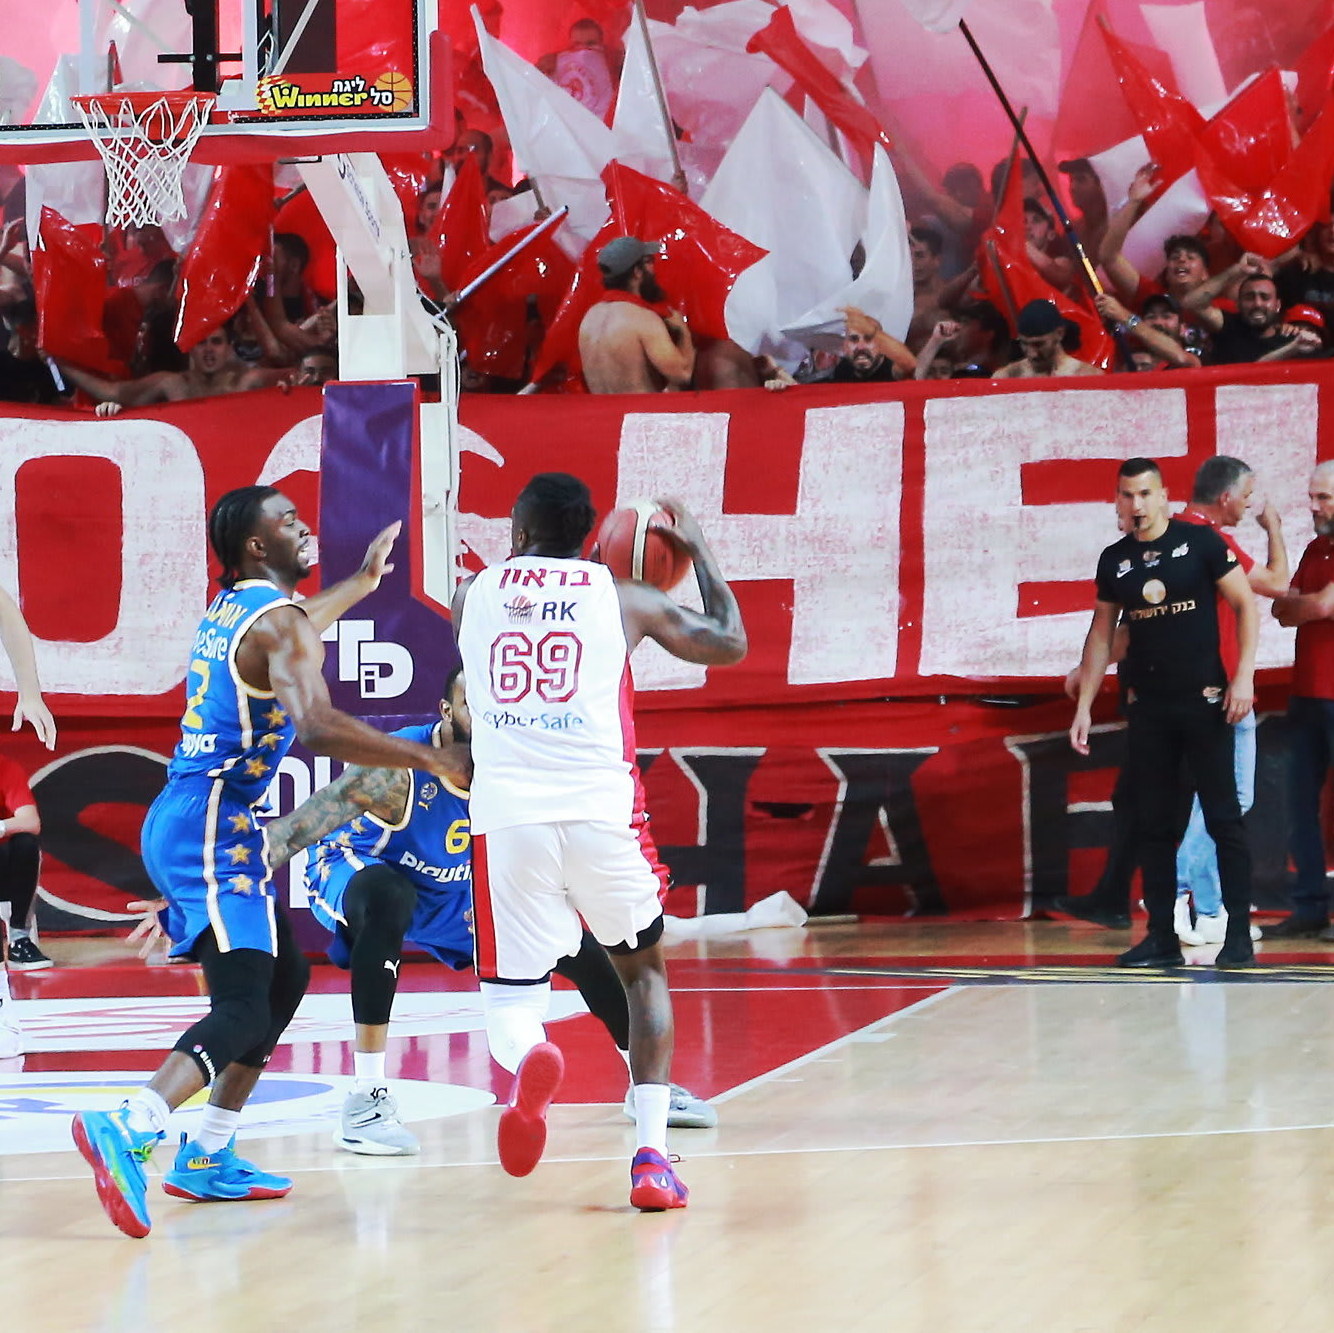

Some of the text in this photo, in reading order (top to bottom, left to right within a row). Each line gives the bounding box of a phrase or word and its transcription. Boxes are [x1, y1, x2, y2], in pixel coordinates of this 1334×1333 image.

[333, 76, 365, 93] ליגת
[370, 87, 394, 106] סל
[499, 568, 592, 589] בראון
[541, 601, 578, 622] RK
[1171, 599, 1197, 615] בנק
[489, 631, 583, 703] 69
[181, 659, 211, 729] 2
[483, 711, 584, 729] CyberSafe
[445, 819, 471, 854] 6
